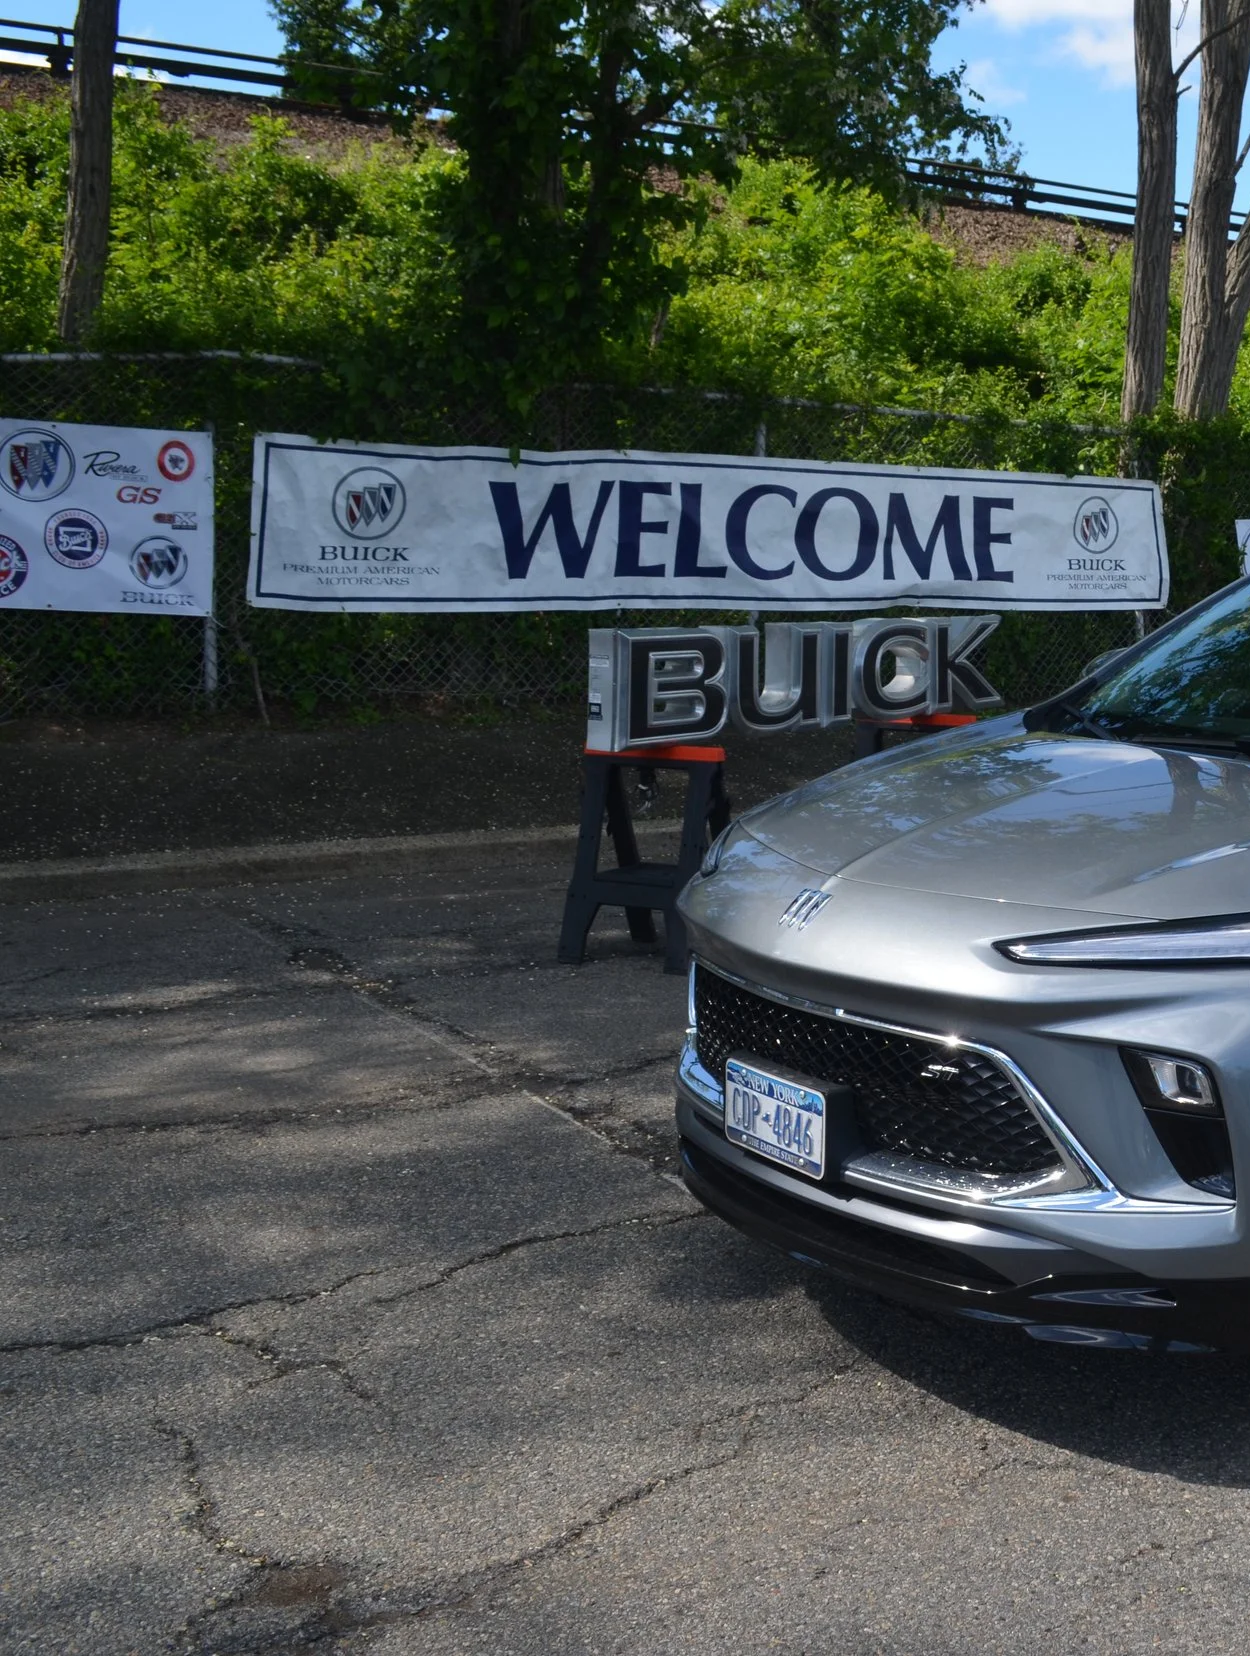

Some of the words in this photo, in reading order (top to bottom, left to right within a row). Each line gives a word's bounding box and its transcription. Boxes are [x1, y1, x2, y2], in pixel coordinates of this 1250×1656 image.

[83, 451, 140, 477] Riviera
[116, 485, 162, 505] GS
[489, 480, 1014, 584] WELCOME
[318, 545, 410, 562] BUICK
[282, 563, 358, 575] PREMIUM
[363, 565, 440, 576] AMERICAN
[1066, 558, 1126, 571] BUICK
[316, 577, 411, 586] MOTORCARS
[1046, 573, 1094, 581] PREMIUM
[1096, 574, 1147, 582] AMERICAN
[1068, 582, 1127, 590] MOTORCARS
[119, 590, 195, 607] BUICK
[613, 614, 1003, 748] BUICK
[920, 1064, 959, 1081] ST
[748, 1074, 770, 1096] NEW
[771, 1082, 800, 1107] YORK
[760, 1141, 780, 1158] EMPIRE
[780, 1149, 800, 1165] STATE
